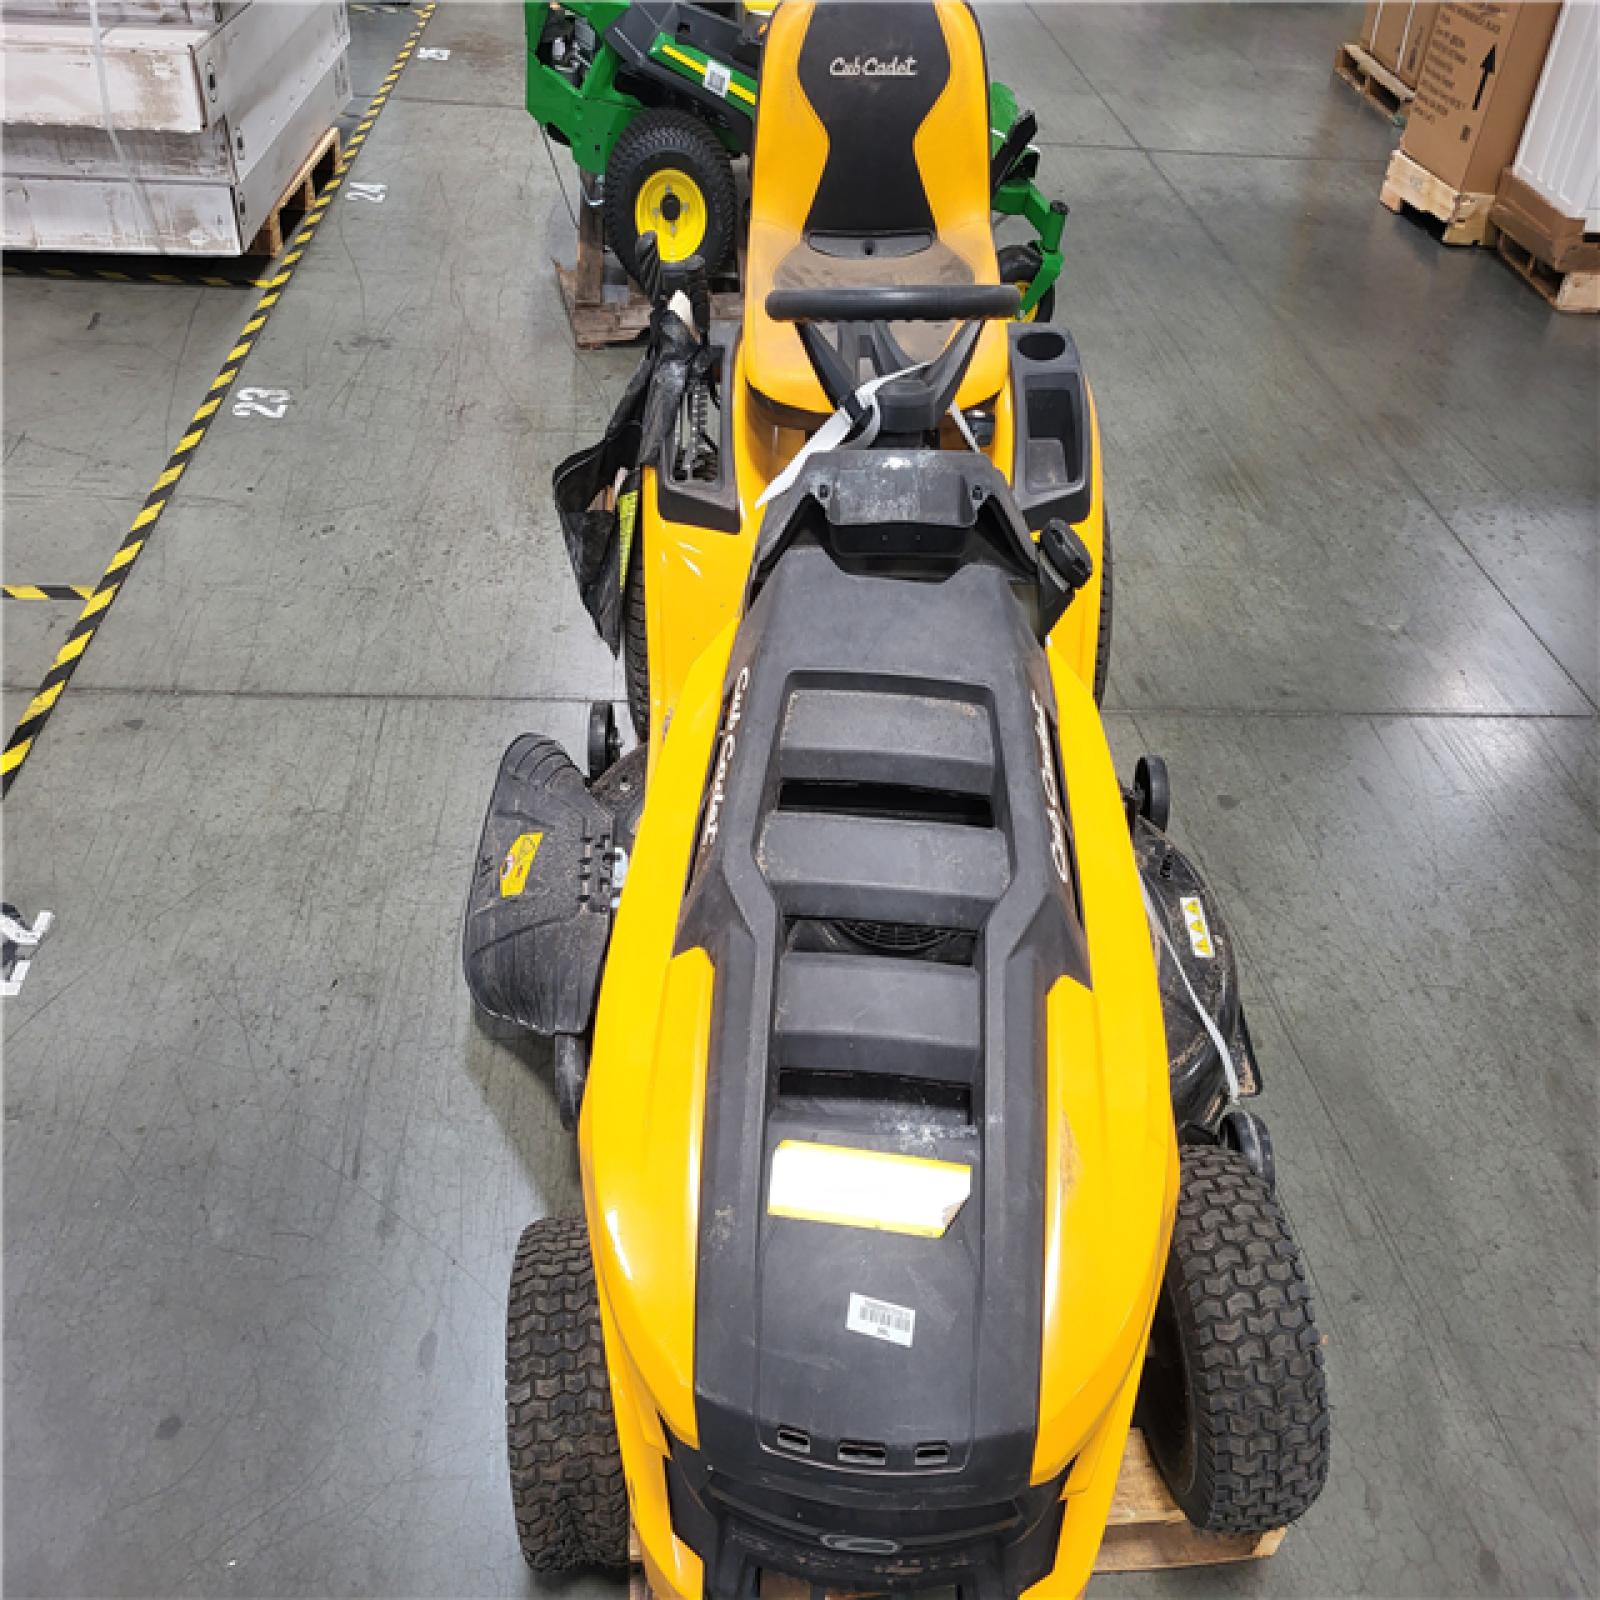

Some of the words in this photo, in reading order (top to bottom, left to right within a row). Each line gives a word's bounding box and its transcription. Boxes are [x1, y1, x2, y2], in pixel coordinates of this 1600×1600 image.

[829, 56, 860, 76] Cub
[865, 55, 918, 76] Cadet
[232, 387, 290, 418] 23
